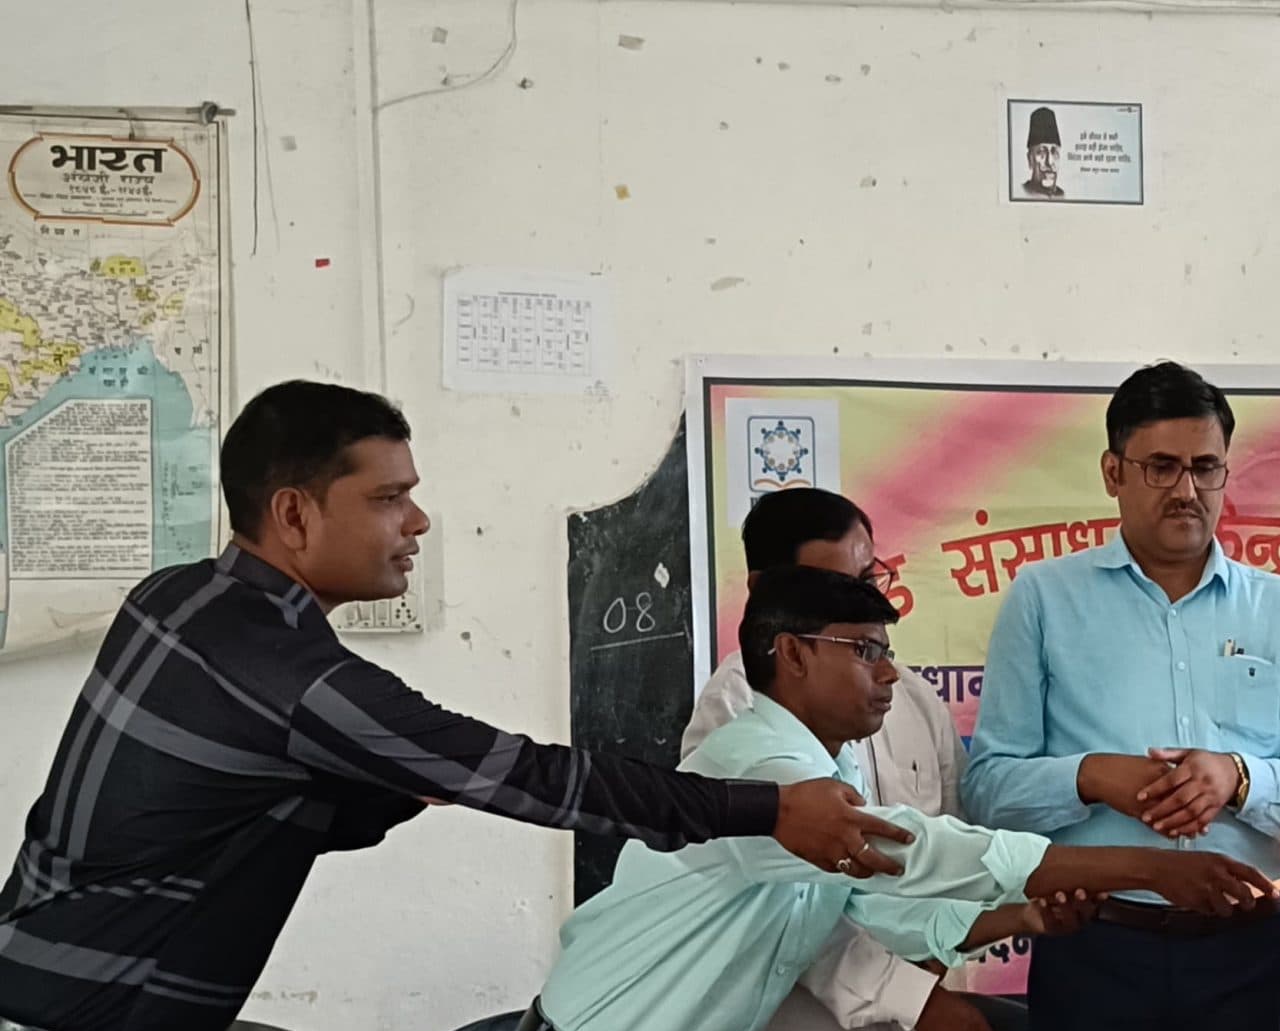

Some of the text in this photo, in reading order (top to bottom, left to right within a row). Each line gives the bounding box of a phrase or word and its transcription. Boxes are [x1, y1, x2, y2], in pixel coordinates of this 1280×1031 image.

[51, 145, 168, 173] भारत
[941, 509, 1121, 597] संसाध
[603, 592, 655, 633] 08
